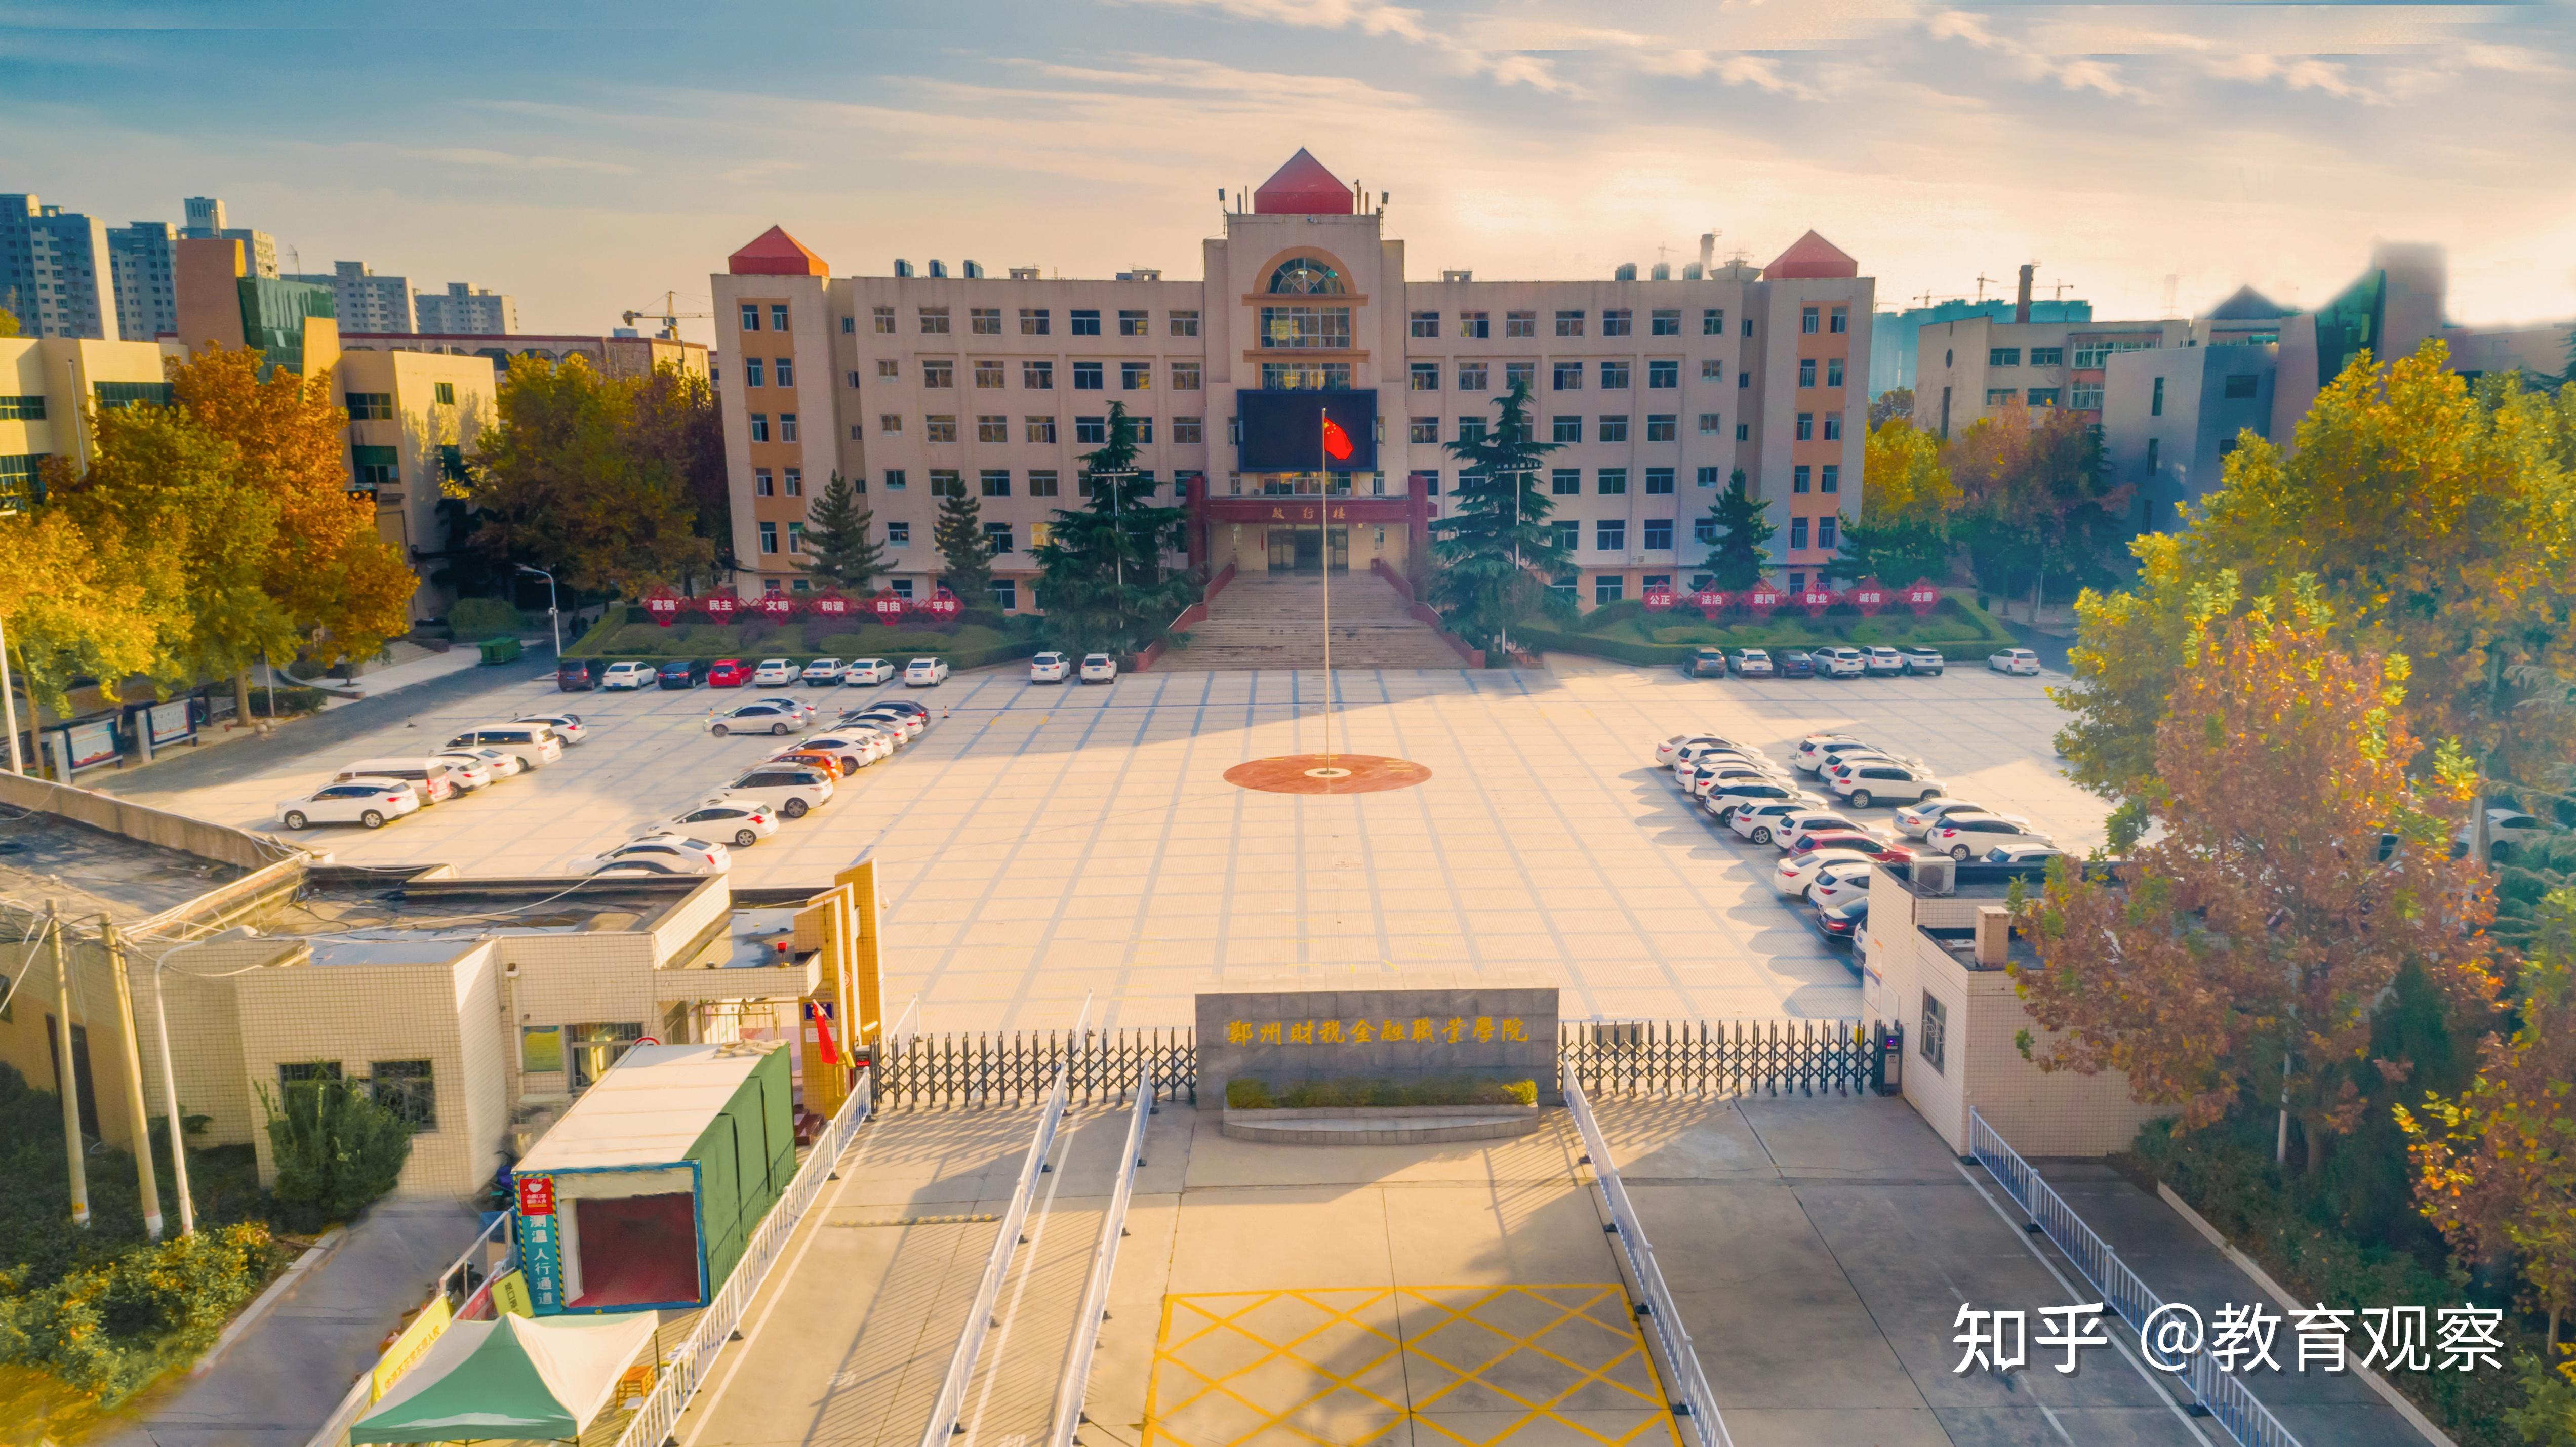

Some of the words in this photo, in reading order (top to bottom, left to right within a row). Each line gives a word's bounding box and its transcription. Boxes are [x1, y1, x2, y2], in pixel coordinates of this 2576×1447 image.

[1650, 595, 1671, 605] 公正
[1702, 595, 1722, 605] 法治
[1754, 594, 1775, 604] 爱国
[1806, 594, 1828, 604] 敬业
[1859, 593, 1880, 603] 诚信
[1912, 592, 1933, 602] 友善
[652, 600, 675, 611] 富强
[709, 601, 733, 611] 民主
[766, 601, 789, 611] 文明
[822, 601, 844, 612] 和谐
[877, 601, 901, 612] 自由
[933, 601, 955, 612] 平等
